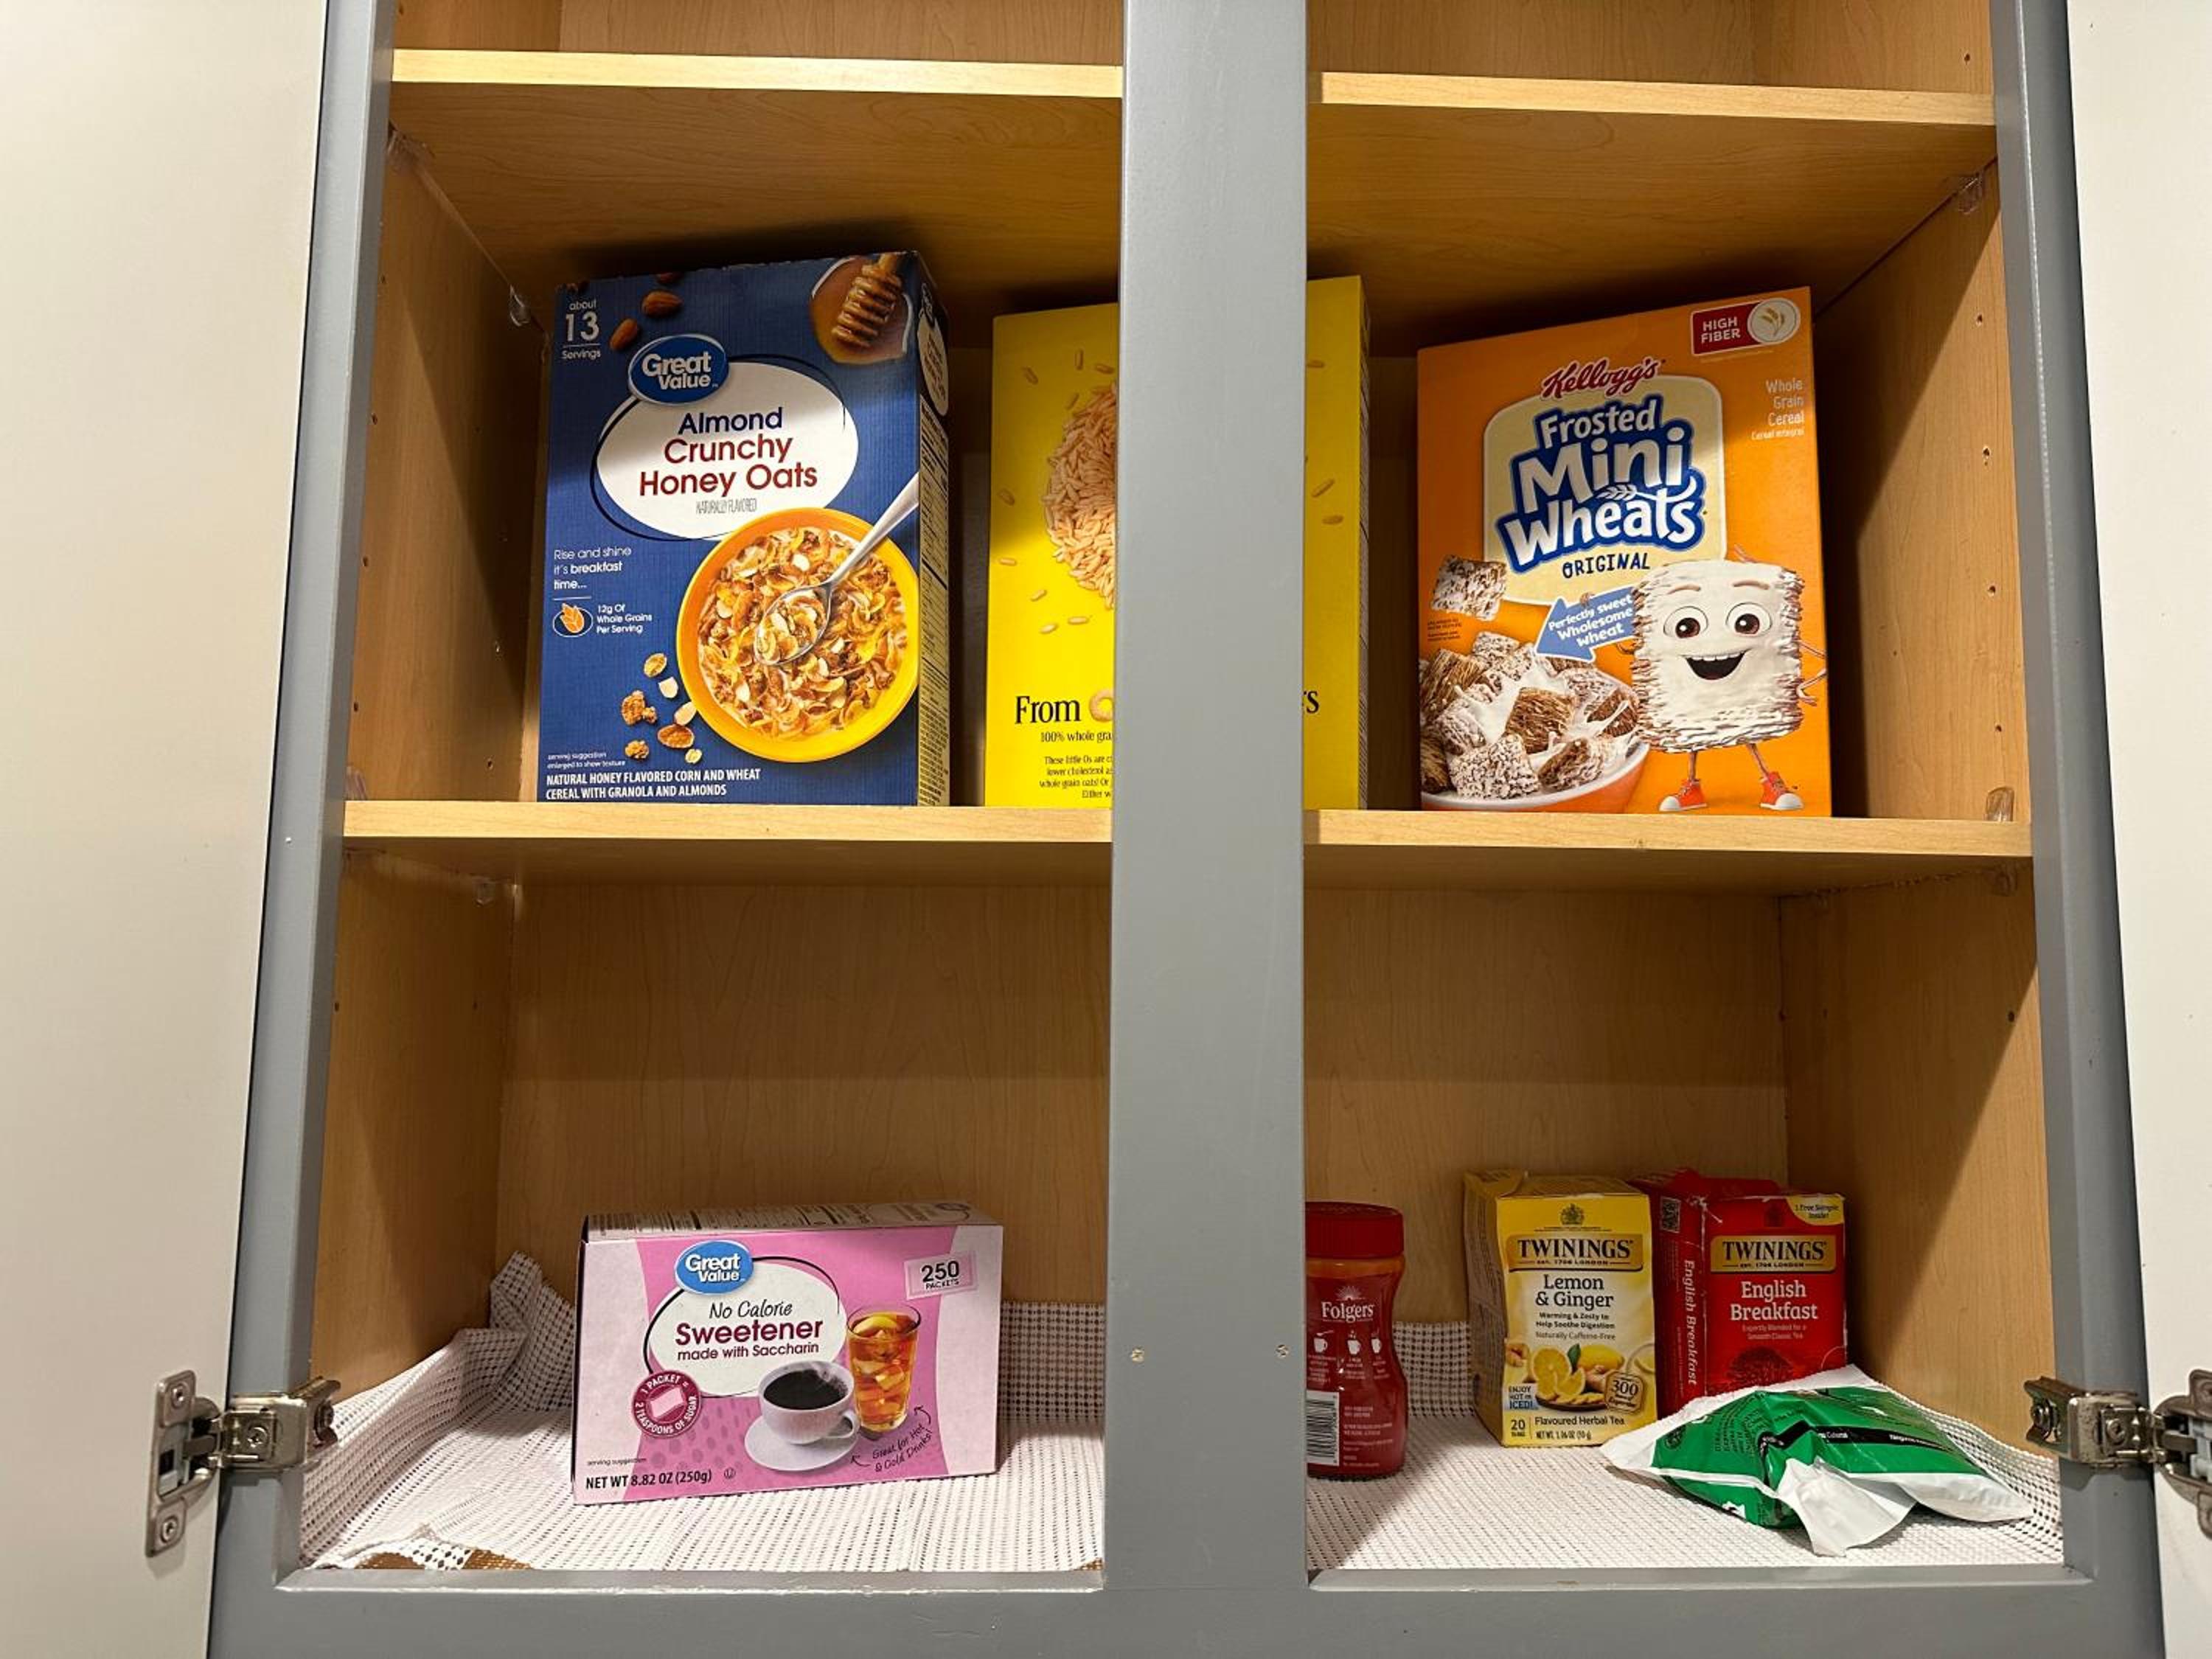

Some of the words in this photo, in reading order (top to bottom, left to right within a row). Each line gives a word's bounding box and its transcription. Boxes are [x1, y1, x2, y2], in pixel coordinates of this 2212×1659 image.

[568, 300, 597, 311] about
[566, 311, 599, 341] 13
[1703, 316, 1738, 331] HIGH
[1701, 329, 1741, 344] FIBER
[562, 349, 601, 361] Servings
[641, 351, 712, 377] Great
[658, 374, 712, 390] Value
[1541, 358, 1659, 399] Kellogg's
[1766, 378, 1803, 393] Whole
[1773, 395, 1804, 409] Grain
[678, 407, 783, 434] Almond
[1540, 399, 1658, 449] Frosted
[1768, 410, 1805, 426] Cereal
[664, 434, 793, 464] Crunchy
[1518, 427, 1685, 514] Mini
[639, 470, 737, 497] Honey
[745, 462, 818, 490] Oats
[696, 501, 726, 515] NATURALLY
[728, 498, 757, 513] FLAVORED
[1504, 478, 1697, 566] Wheats
[554, 549, 574, 560] Rise
[577, 547, 601, 558] and
[602, 546, 632, 557] shine
[554, 565, 568, 575] it's
[570, 561, 623, 574] breakfast
[1562, 552, 1651, 579] ORIGINAL
[597, 605, 613, 614] 12g
[614, 605, 626, 613] Of
[625, 613, 653, 622] Grains
[1548, 609, 1595, 630] Perfectly
[1597, 594, 1633, 613] sweet
[597, 626, 610, 634] Per
[611, 625, 644, 634] Serving
[1576, 623, 1625, 647] wheat
[1015, 695, 1082, 724] From
[1041, 731, 1065, 742] 100%
[1067, 731, 1095, 741] whole
[1096, 732, 1113, 743] gra
[1045, 756, 1063, 764] These
[546, 774, 588, 785] NATURAL
[589, 773, 621, 784] HONEY
[624, 771, 672, 783] FLAVORED
[675, 771, 700, 781] CORN
[703, 770, 725, 781] AND
[726, 768, 761, 780] WHEAT
[546, 788, 580, 800] CEREAL
[581, 787, 607, 799] WITH
[608, 786, 653, 797] GRANOLA
[655, 785, 676, 796] AND
[678, 784, 727, 796] ALMONDS
[1517, 1238, 1630, 1259] TWININGS
[1722, 1241, 1824, 1261] TWININGS
[685, 1253, 741, 1272] Great
[698, 1270, 740, 1282] Value
[922, 1261, 959, 1282] 250
[925, 1279, 959, 1289] PACKETS
[1543, 1274, 1604, 1290] Lemon
[1682, 1260, 1695, 1312] English
[1741, 1280, 1806, 1302] English
[709, 1302, 732, 1318] No
[738, 1299, 793, 1317] Calorie
[1535, 1292, 1549, 1306] &
[1554, 1292, 1614, 1311] Ginger
[1321, 1301, 1374, 1323] Folgers
[1580, 1312, 1599, 1320] Zesty
[1731, 1301, 1819, 1321] Breakfast
[675, 1320, 823, 1346] Sweetener
[1581, 1321, 1615, 1329] Digestion
[1536, 1332, 1568, 1340] Naturally
[1568, 1332, 1615, 1340] Caffeine-Free
[678, 1346, 718, 1360] made
[723, 1345, 748, 1357] with
[752, 1342, 818, 1357] Saccharin
[1686, 1315, 1698, 1385] Breakfast
[647, 1374, 681, 1389] PACKET
[1612, 1380, 1638, 1396] 300
[636, 1409, 674, 1434] TEASPOONS
[675, 1419, 685, 1430] OF
[684, 1395, 697, 1422] SUGAR
[1535, 1416, 1576, 1425] Flavoured
[1579, 1416, 1607, 1425] Herbal
[1511, 1419, 1526, 1430] 20
[872, 1444, 897, 1459] Great
[897, 1437, 908, 1450] for
[910, 1423, 925, 1439] Hot
[885, 1453, 905, 1469] Cold
[586, 1477, 608, 1489] NET
[610, 1475, 628, 1487] WT
[630, 1474, 655, 1486] 8.82
[658, 1472, 673, 1484] OZ
[675, 1470, 712, 1484] (250g)
